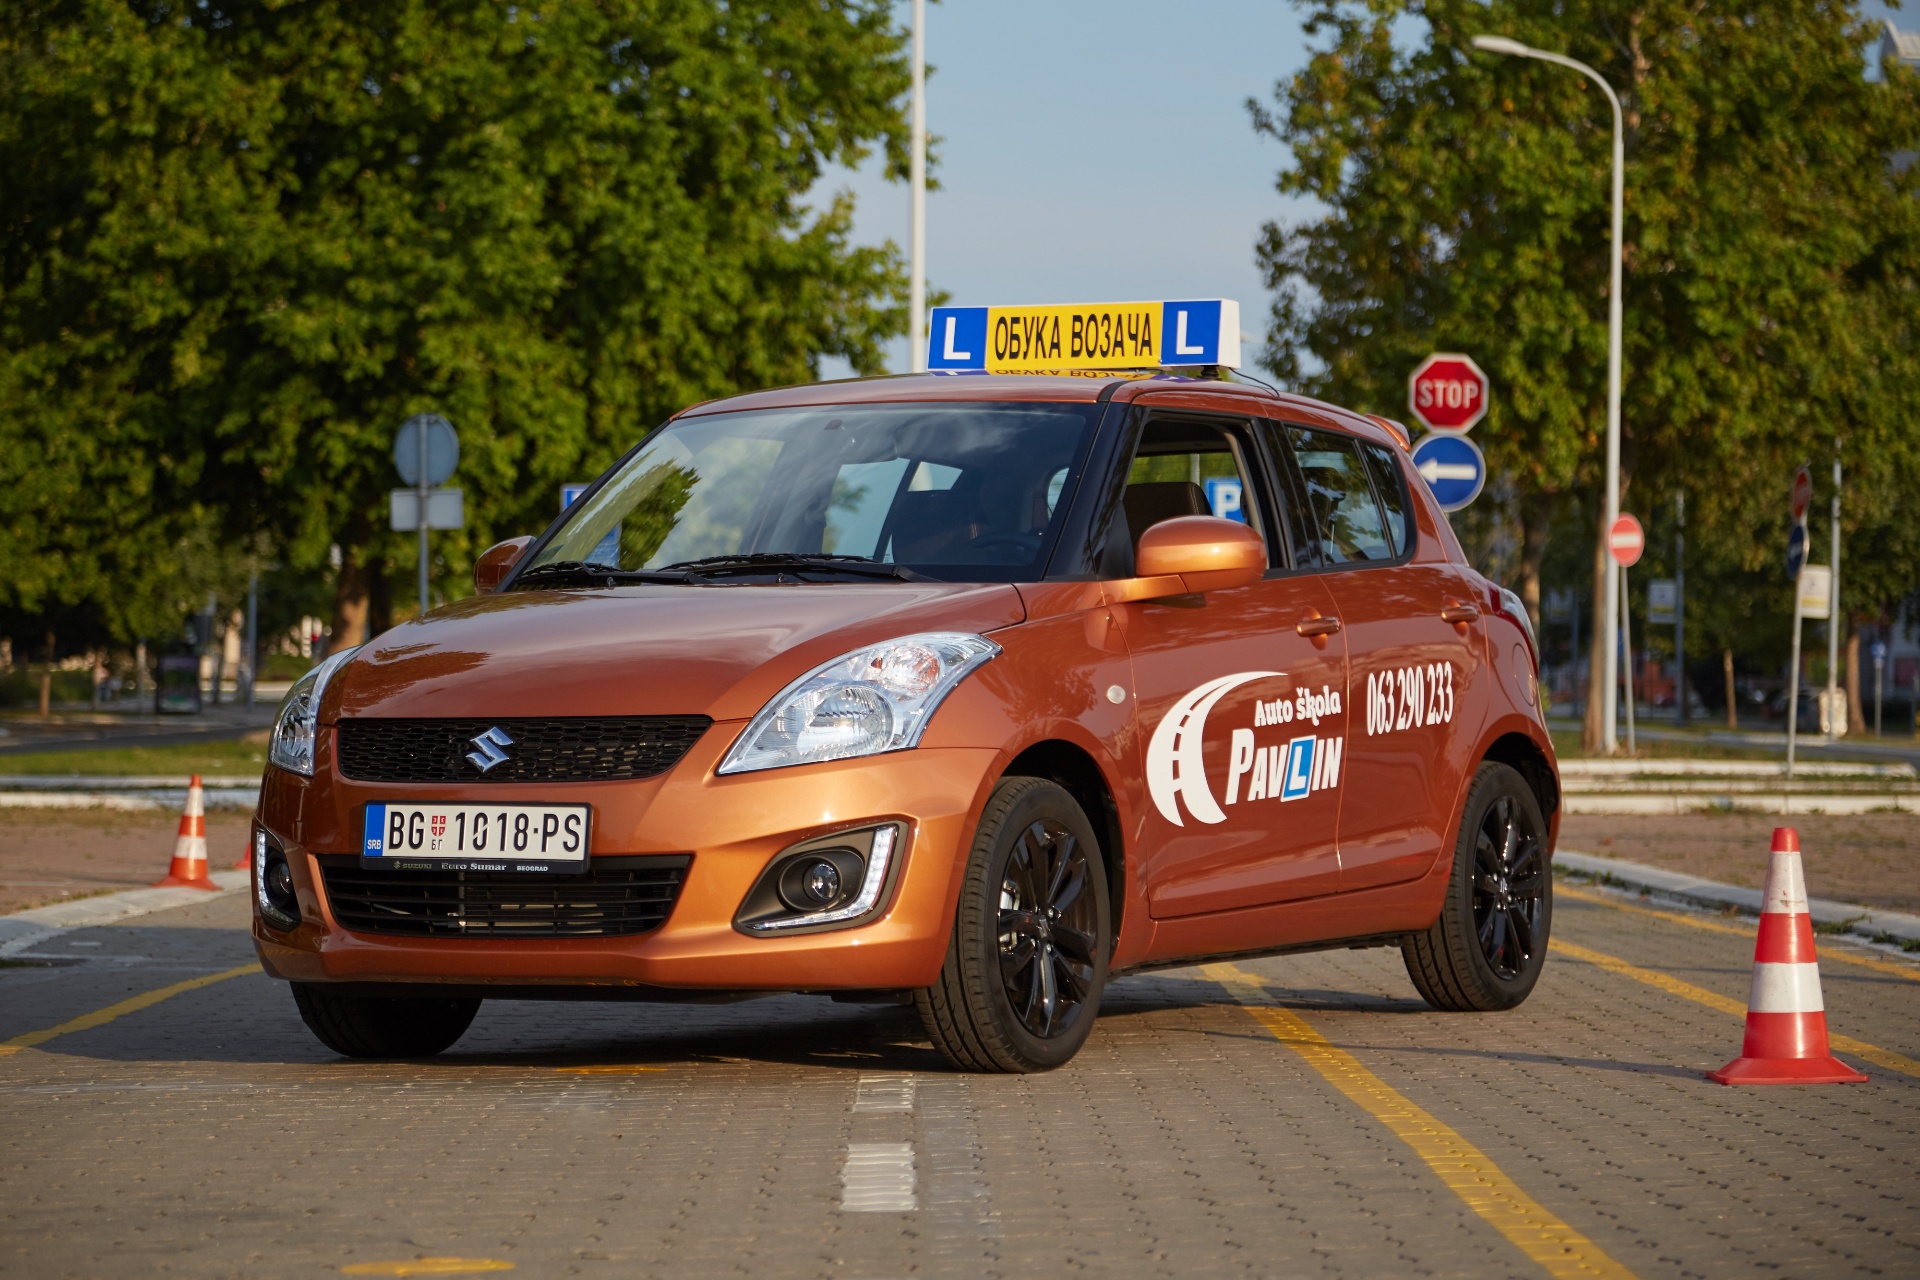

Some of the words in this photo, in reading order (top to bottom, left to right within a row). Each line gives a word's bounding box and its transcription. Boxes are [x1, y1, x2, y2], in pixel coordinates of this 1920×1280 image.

[943, 317, 971, 360] L
[994, 315, 1062, 361] ОБУКА
[1070, 312, 1153, 359] ВОЗАЧА
[1176, 310, 1204, 355] L
[1417, 379, 1479, 409] STOP
[1214, 482, 1243, 518] P
[1254, 699, 1294, 727] Auto
[1295, 685, 1342, 726] škola
[1366, 669, 1396, 737] 063
[1396, 666, 1426, 731] 290
[1426, 660, 1454, 727] 233
[367, 839, 381, 850] SRB
[388, 811, 425, 850] BG
[441, 862, 468, 871] Euro
[470, 862, 507, 871] Sumar
[516, 865, 549, 873] BEOGRAD
